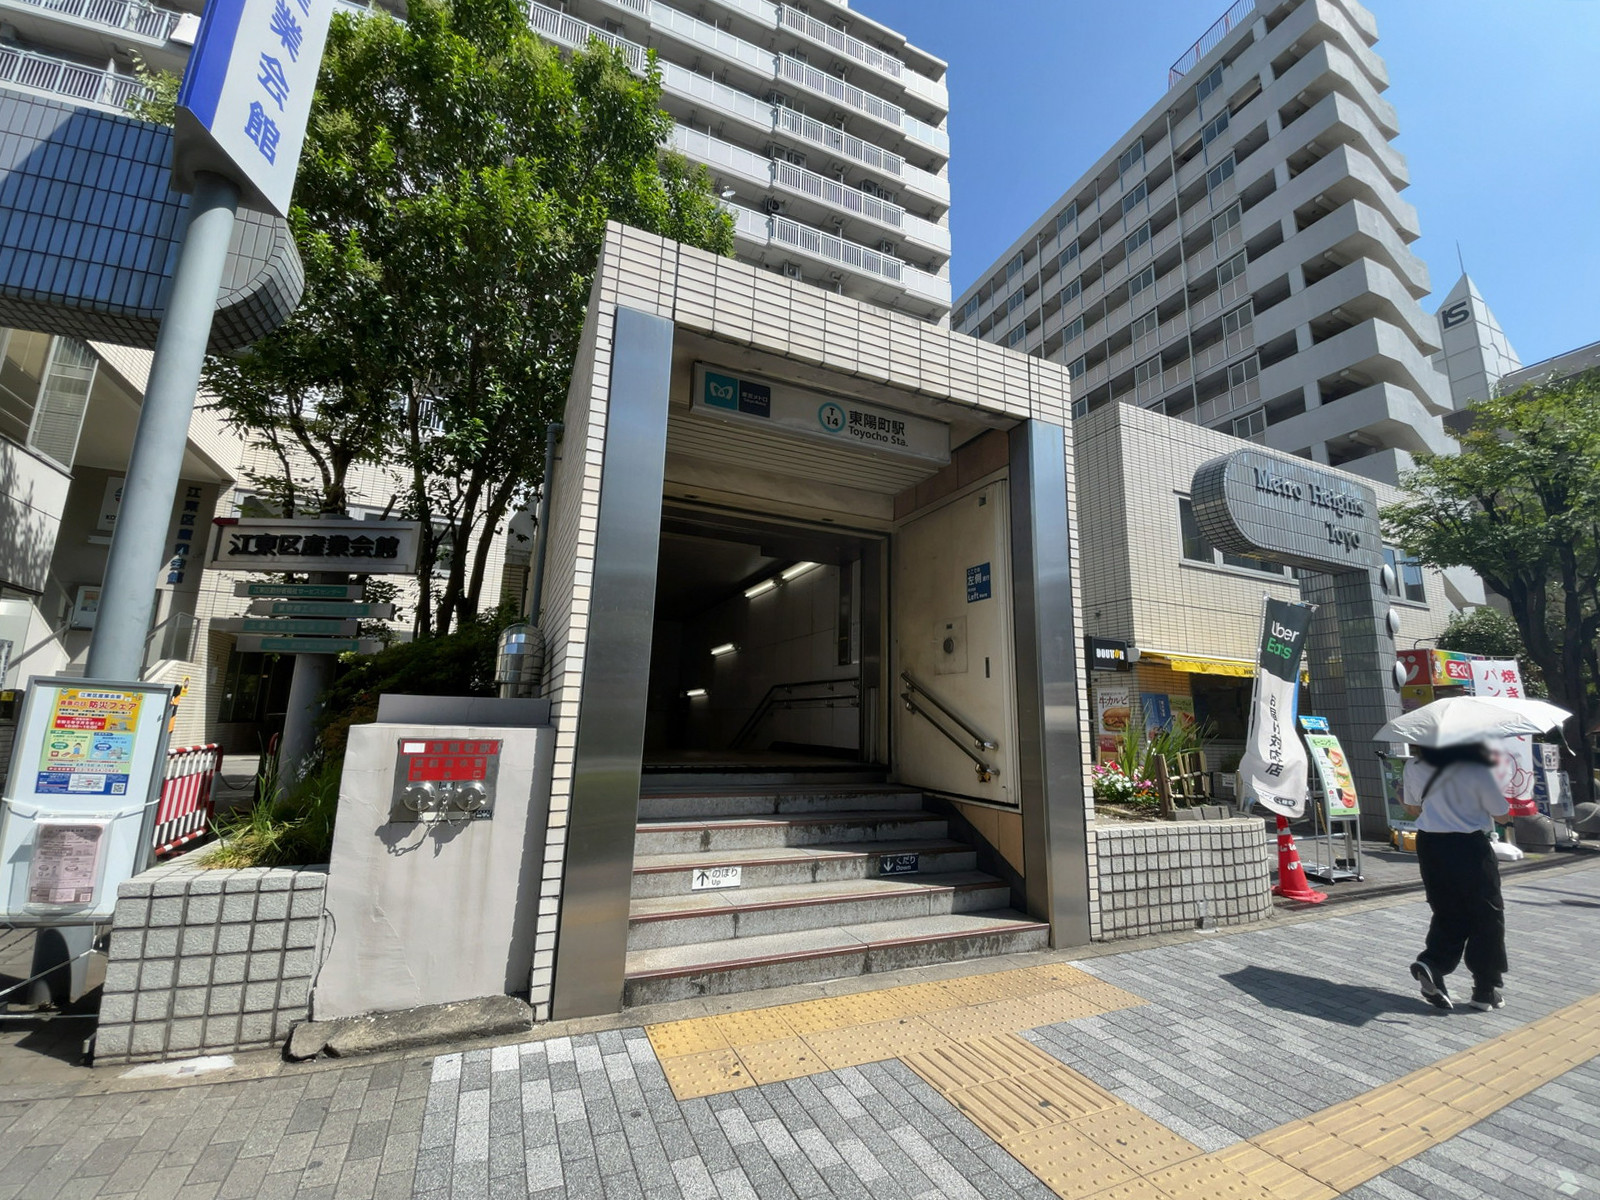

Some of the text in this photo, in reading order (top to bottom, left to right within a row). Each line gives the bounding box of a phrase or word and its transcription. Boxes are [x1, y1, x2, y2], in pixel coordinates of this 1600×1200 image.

[244, 0, 312, 167] 業会館
[826, 416, 839, 427] 14
[829, 407, 836, 416] T
[848, 410, 905, 436] 東陽町駅
[849, 425, 909, 447] Toyocho Sta.
[1254, 467, 1364, 519] Metro Heights
[228, 532, 401, 559] 江東区産業会館
[1324, 520, 1361, 554] Toyo
[1270, 619, 1300, 643] Uber
[1096, 647, 1125, 661] DOUTOR
[1265, 636, 1293, 660] Eats
[88, 700, 136, 710] 防災フェア
[896, 855, 917, 866] くだり
[711, 879, 721, 887] Up
[712, 868, 738, 880] のぼり
